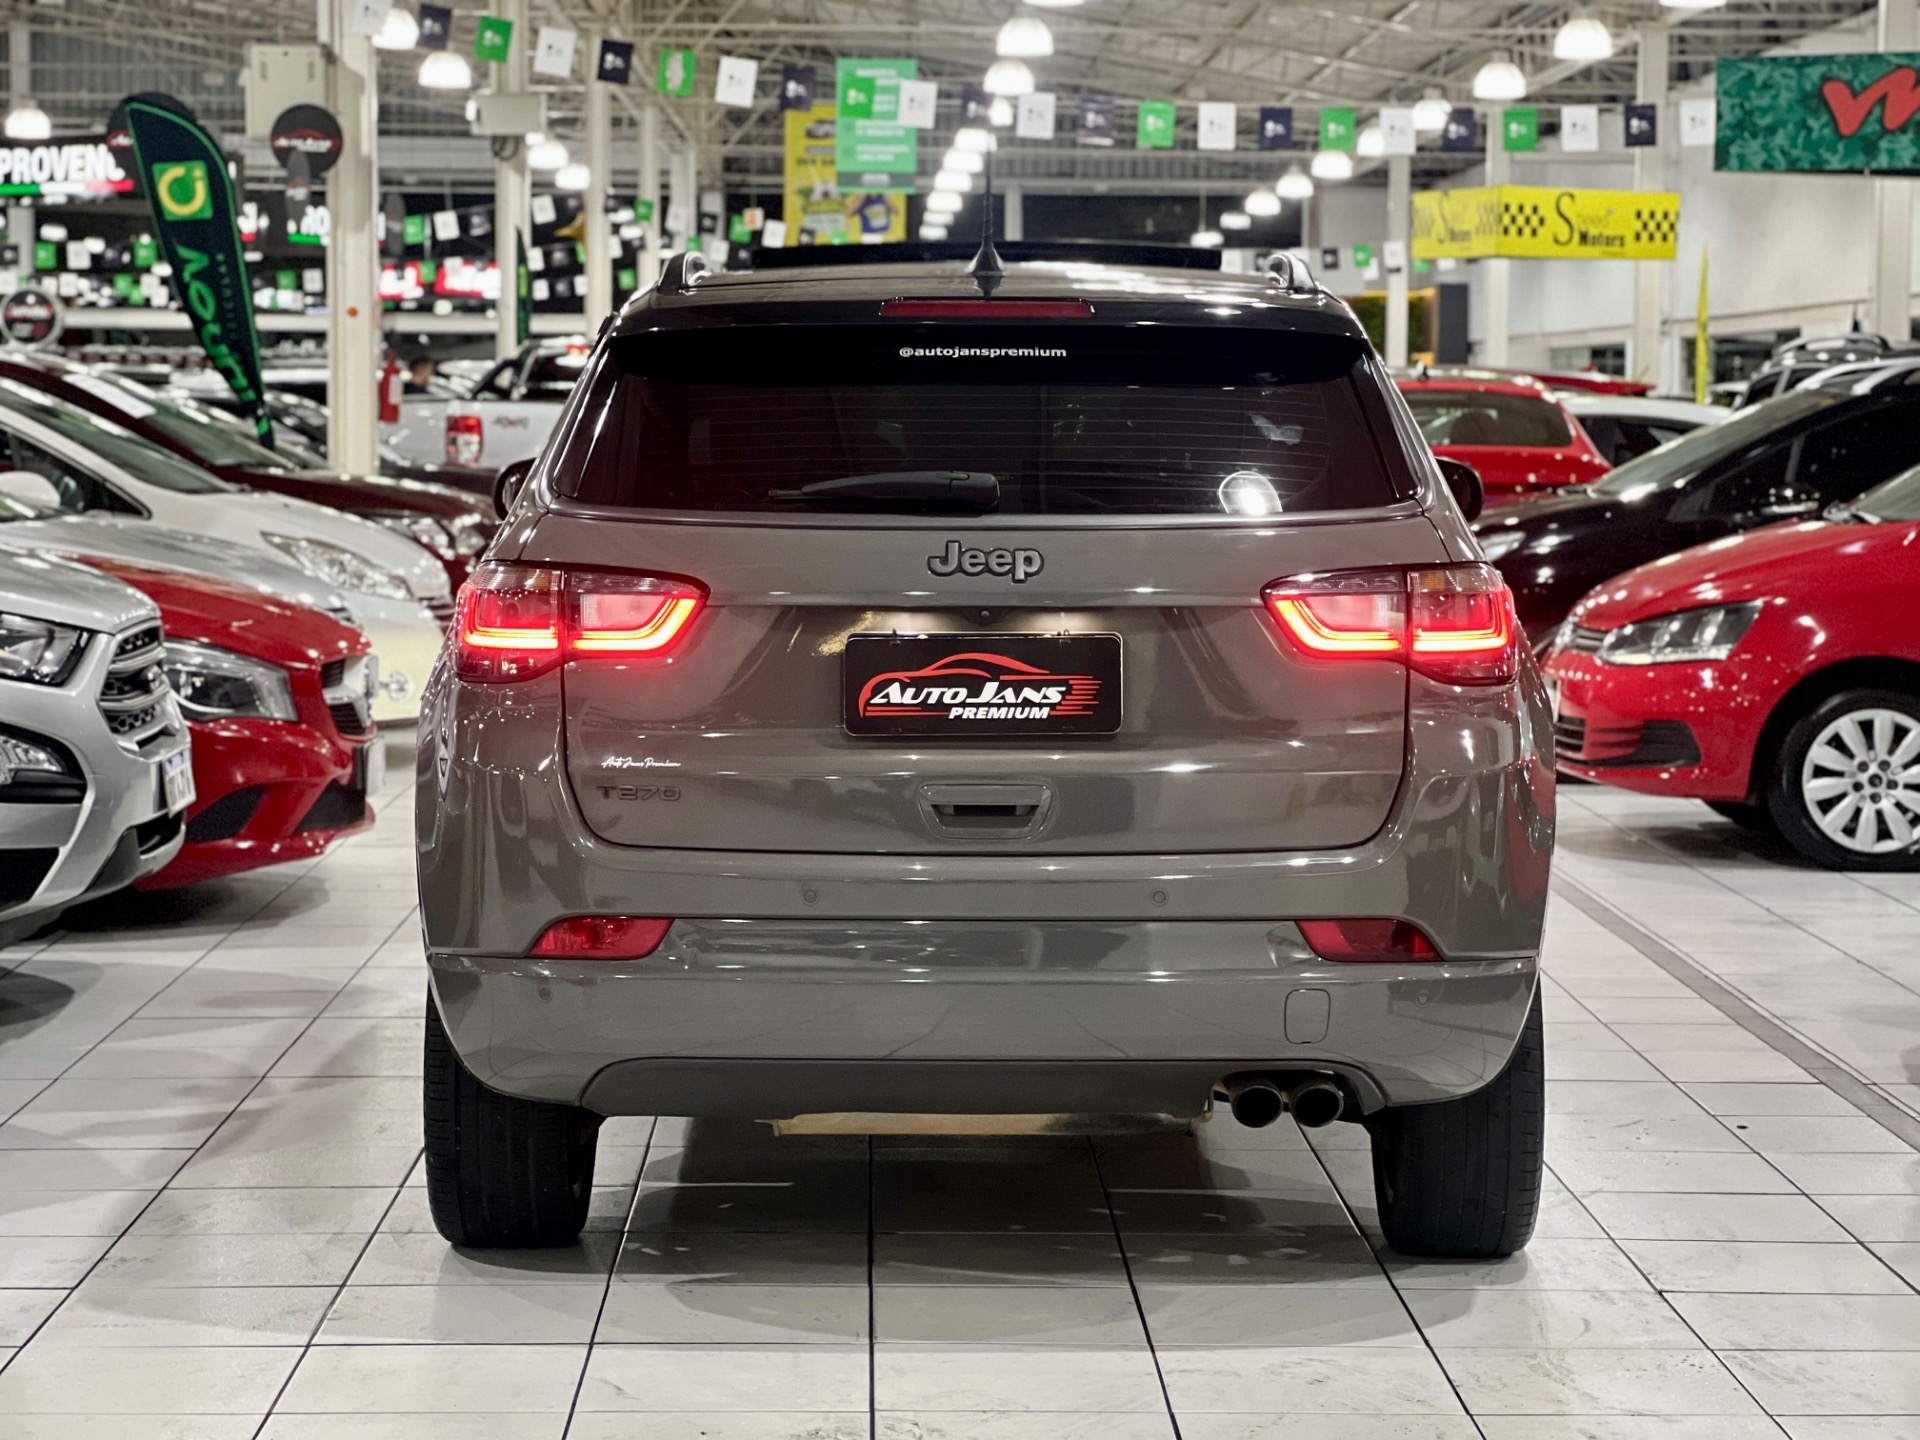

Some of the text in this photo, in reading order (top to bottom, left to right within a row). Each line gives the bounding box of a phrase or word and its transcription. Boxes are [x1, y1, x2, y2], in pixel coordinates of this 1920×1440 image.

[899, 346, 1067, 358] @autojanspremium
[927, 540, 1044, 584] Jeep
[948, 706, 1051, 719] PREMIUM
[596, 785, 681, 801] T270
